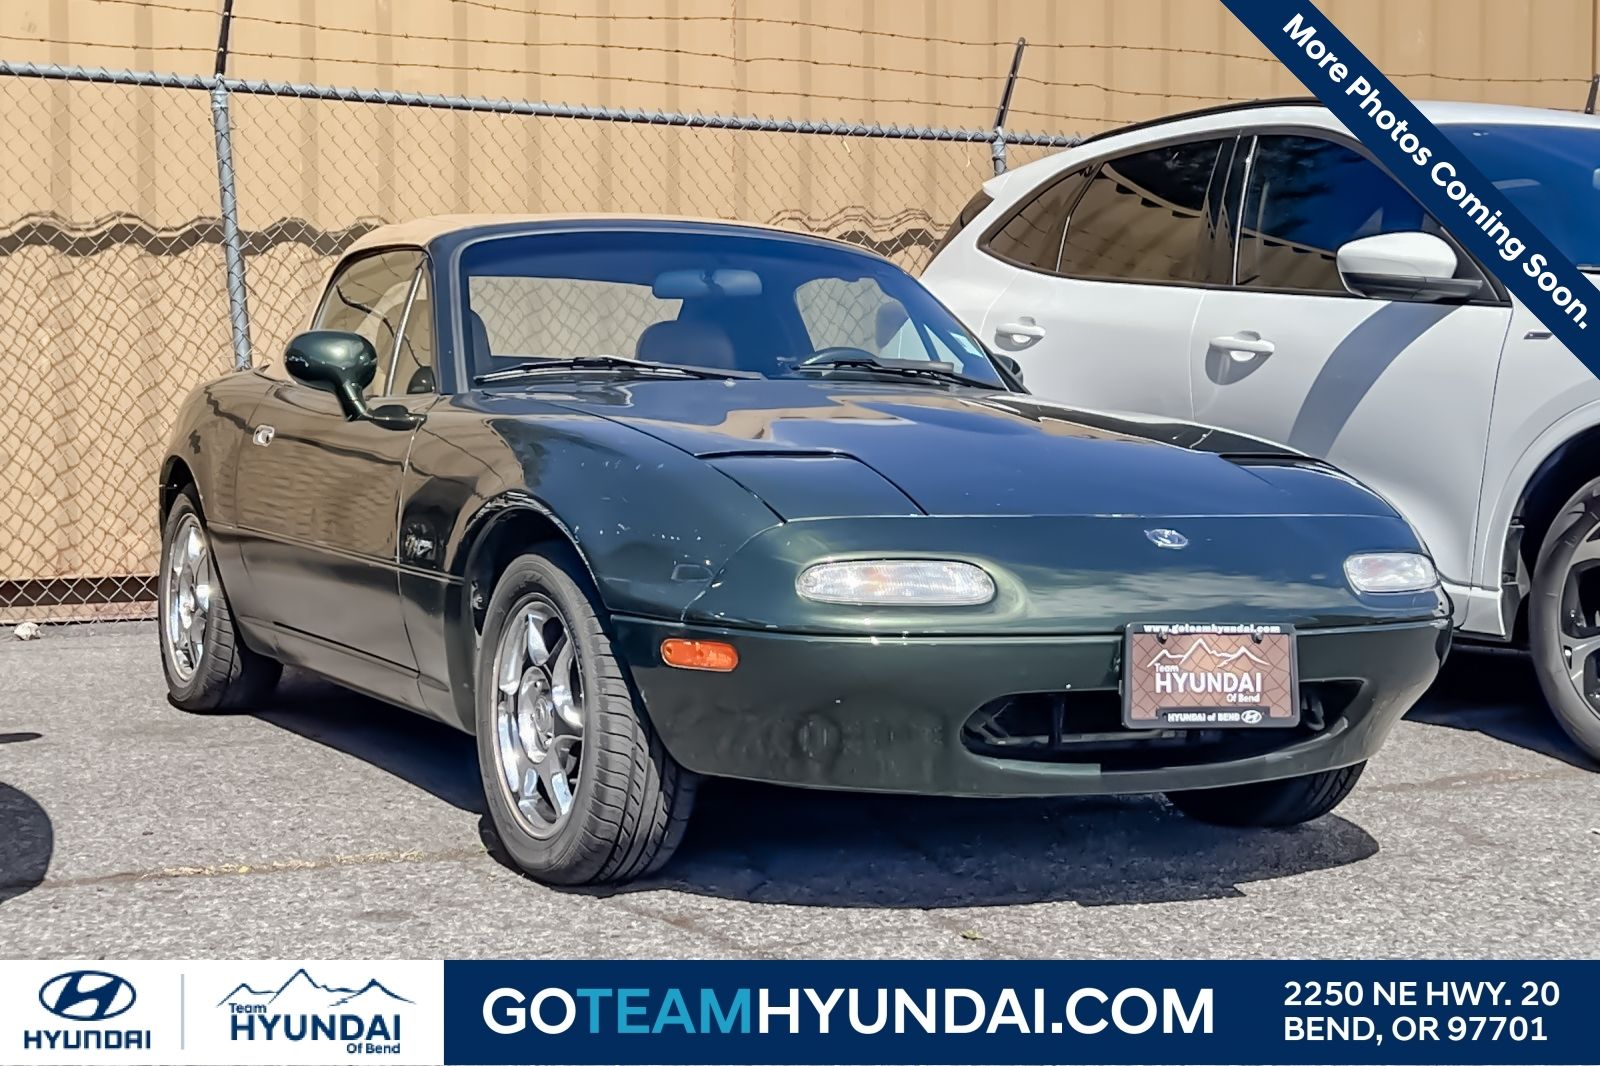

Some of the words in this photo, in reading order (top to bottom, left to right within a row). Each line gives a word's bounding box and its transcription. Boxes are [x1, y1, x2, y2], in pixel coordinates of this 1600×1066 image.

[1143, 623, 1281, 634] www.goteamhyundai.com
[1154, 663, 1180, 673] Team
[1154, 672, 1262, 693] HYUNDAI
[1226, 693, 1237, 703] Of
[1238, 693, 1261, 703] Bend
[1167, 713, 1206, 722] HYUNDAI
[1207, 713, 1217, 722] of
[1217, 713, 1240, 722] BEND
